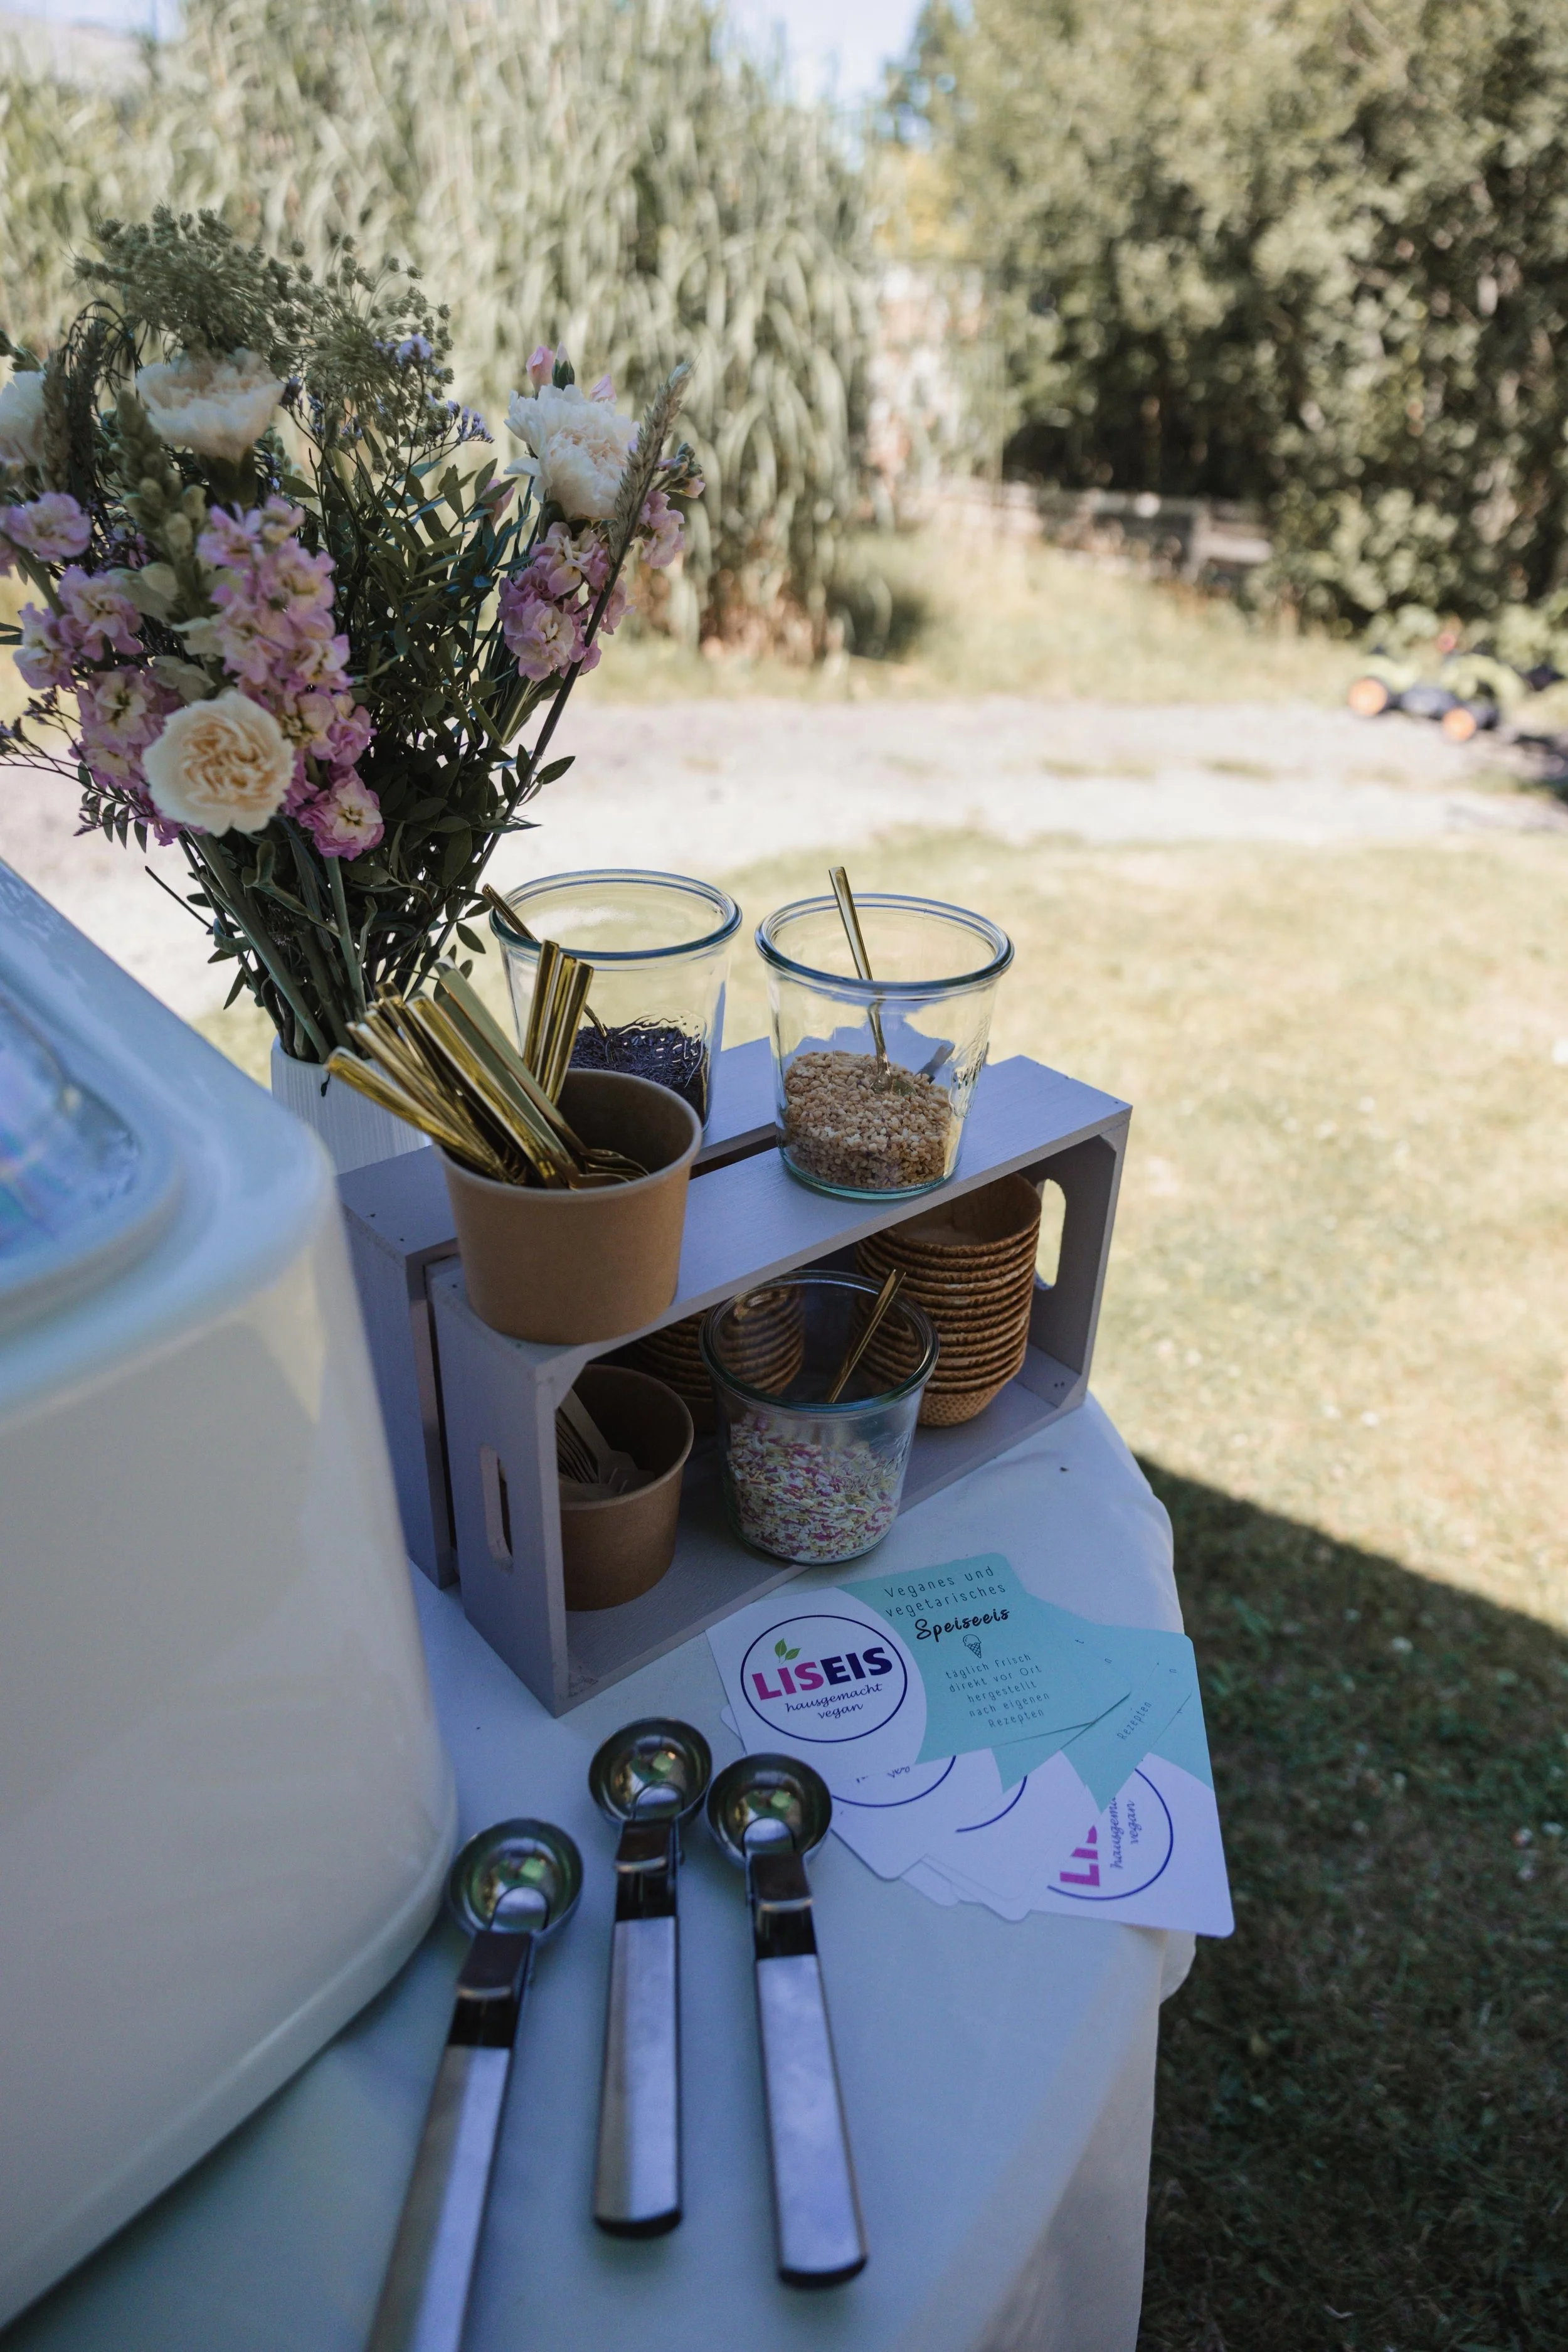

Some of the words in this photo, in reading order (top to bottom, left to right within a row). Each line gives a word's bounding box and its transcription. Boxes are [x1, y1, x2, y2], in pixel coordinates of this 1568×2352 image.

[884, 1575, 955, 1598] Veganes
[964, 1566, 994, 1582] und
[885, 1583, 1005, 1617] vegetarisches
[914, 1609, 1010, 1642] Speiseeis
[751, 1647, 893, 1701] LISEIS
[945, 1663, 989, 1679] täglich
[995, 1653, 1032, 1668] frisch
[949, 1678, 987, 1693] direkt
[993, 1672, 1012, 1683] vor
[1019, 1664, 1042, 1676] Ort
[785, 1683, 883, 1713] hausgemacht
[968, 1681, 1037, 1703] hergestellt
[968, 1705, 997, 1717] nach
[1004, 1692, 1049, 1711] eigenen
[817, 1703, 863, 1719] vegan
[987, 1708, 1044, 1728] Rezepten
[1116, 1701, 1152, 1741] Rezepten
[1126, 1799, 1142, 1844] vegan
